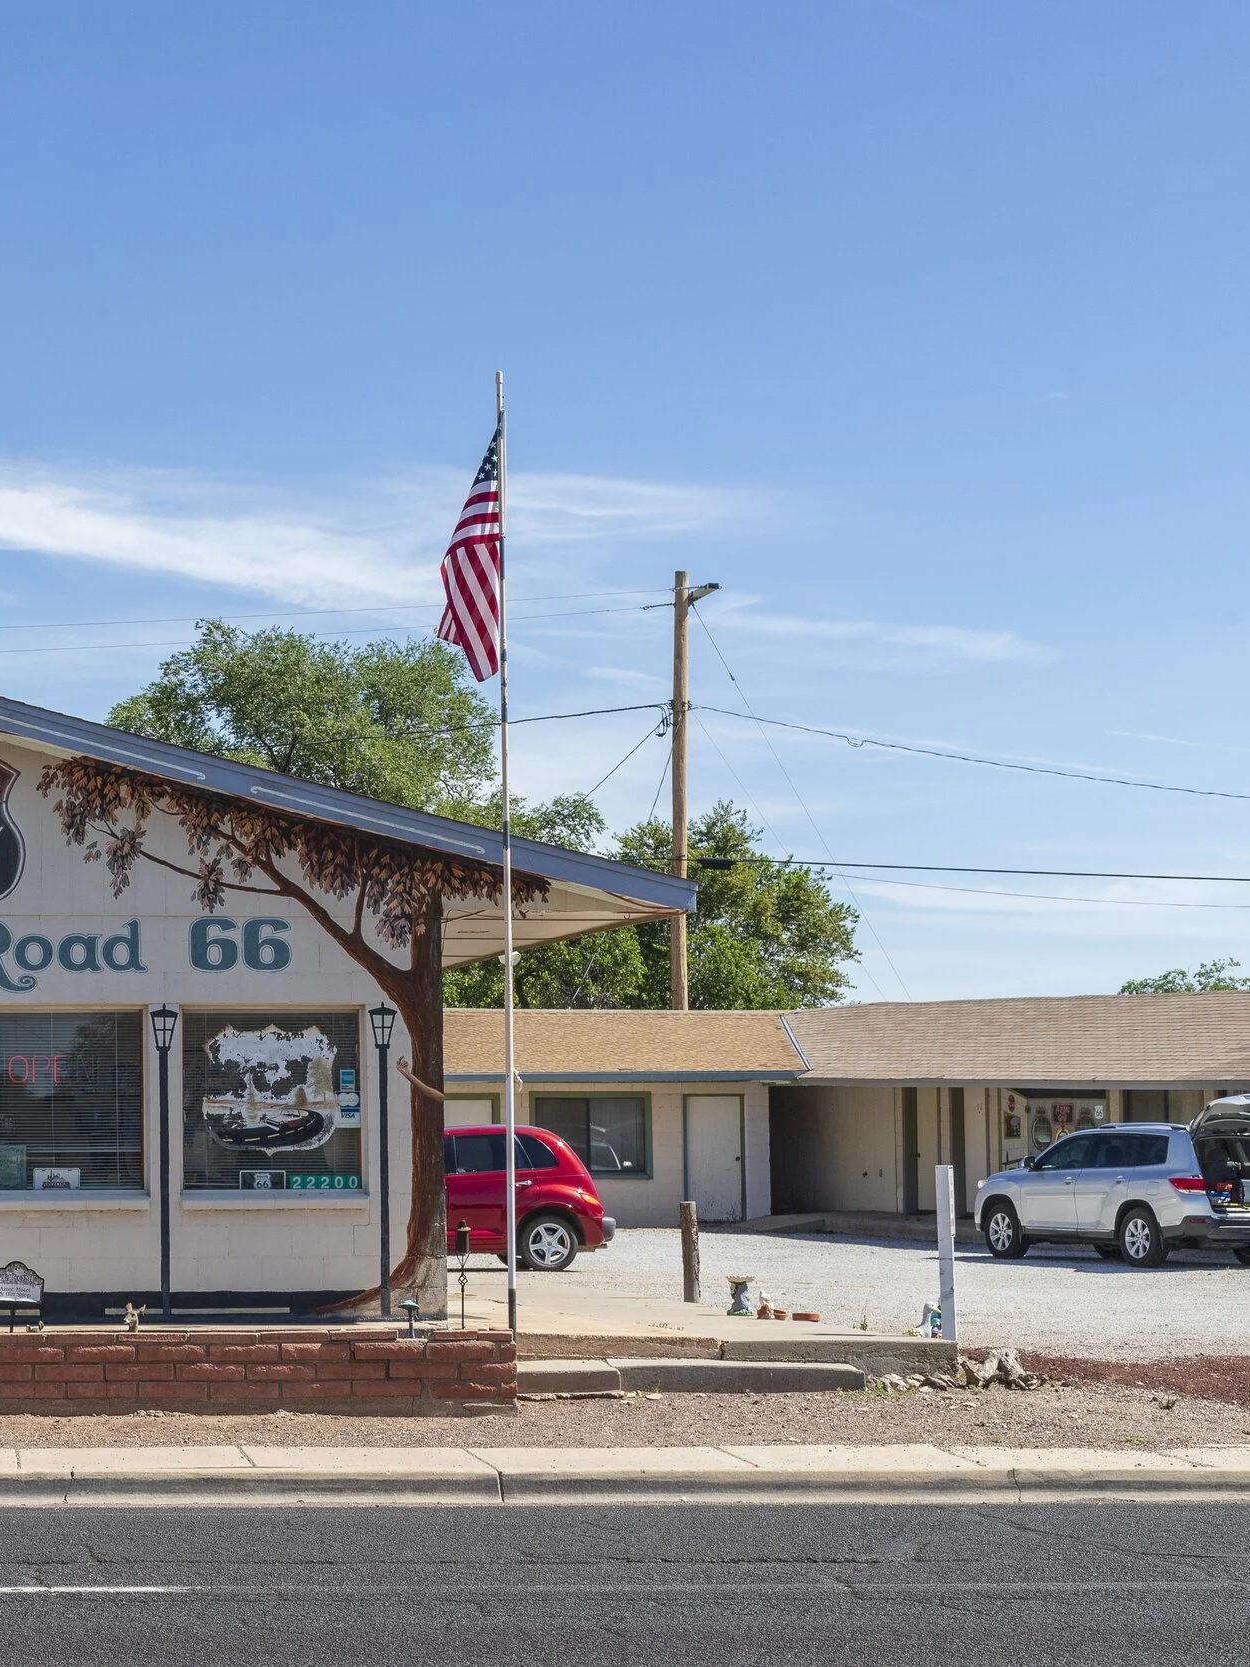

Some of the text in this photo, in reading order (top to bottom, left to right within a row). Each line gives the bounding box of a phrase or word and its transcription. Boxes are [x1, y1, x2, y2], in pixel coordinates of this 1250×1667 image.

[188, 915, 293, 974] 66
[256, 1179, 269, 1189] 66
[293, 1176, 358, 1189] 22200
